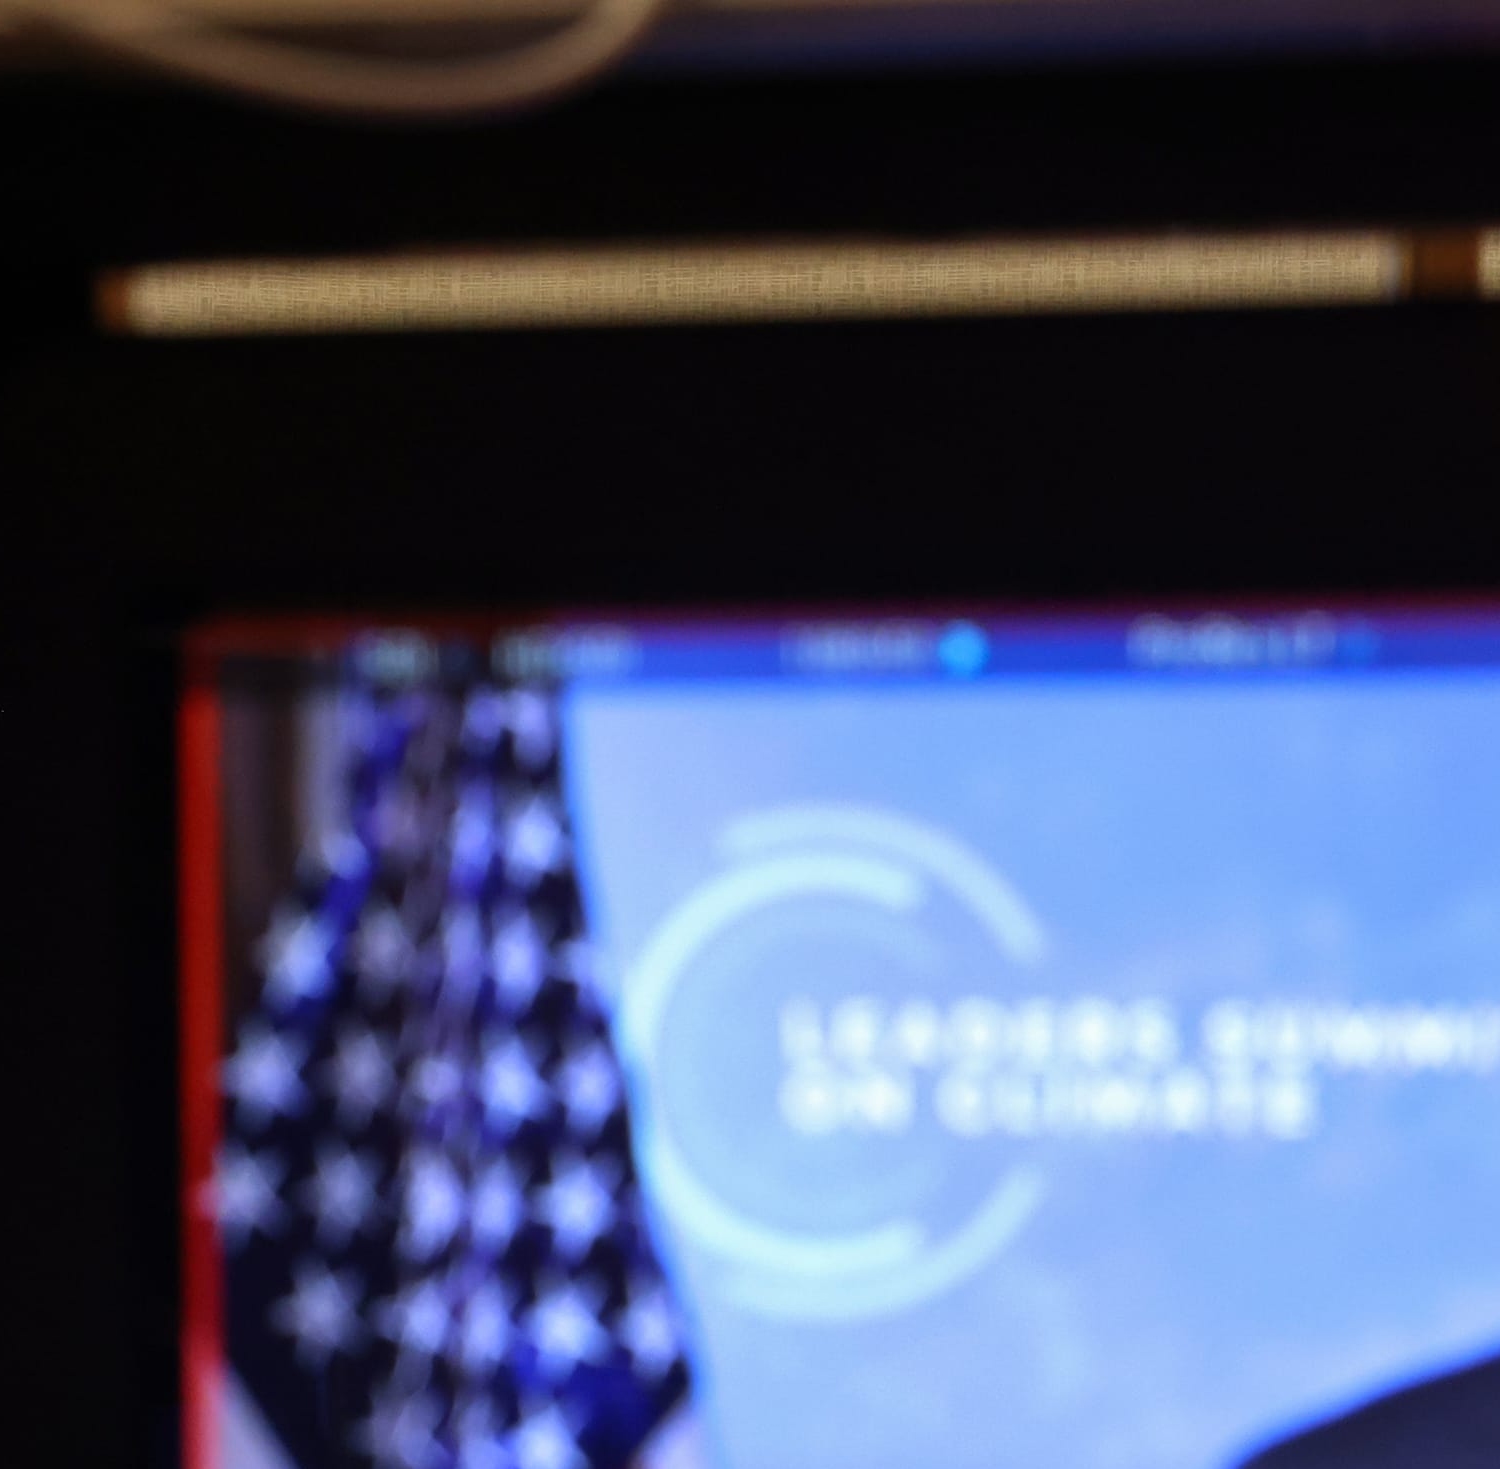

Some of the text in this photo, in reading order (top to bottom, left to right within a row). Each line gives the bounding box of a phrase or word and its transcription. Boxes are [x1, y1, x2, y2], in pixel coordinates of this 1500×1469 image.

[780, 998, 1176, 1068] LEADERS
[780, 1067, 1318, 1140] ON CLIMATE
